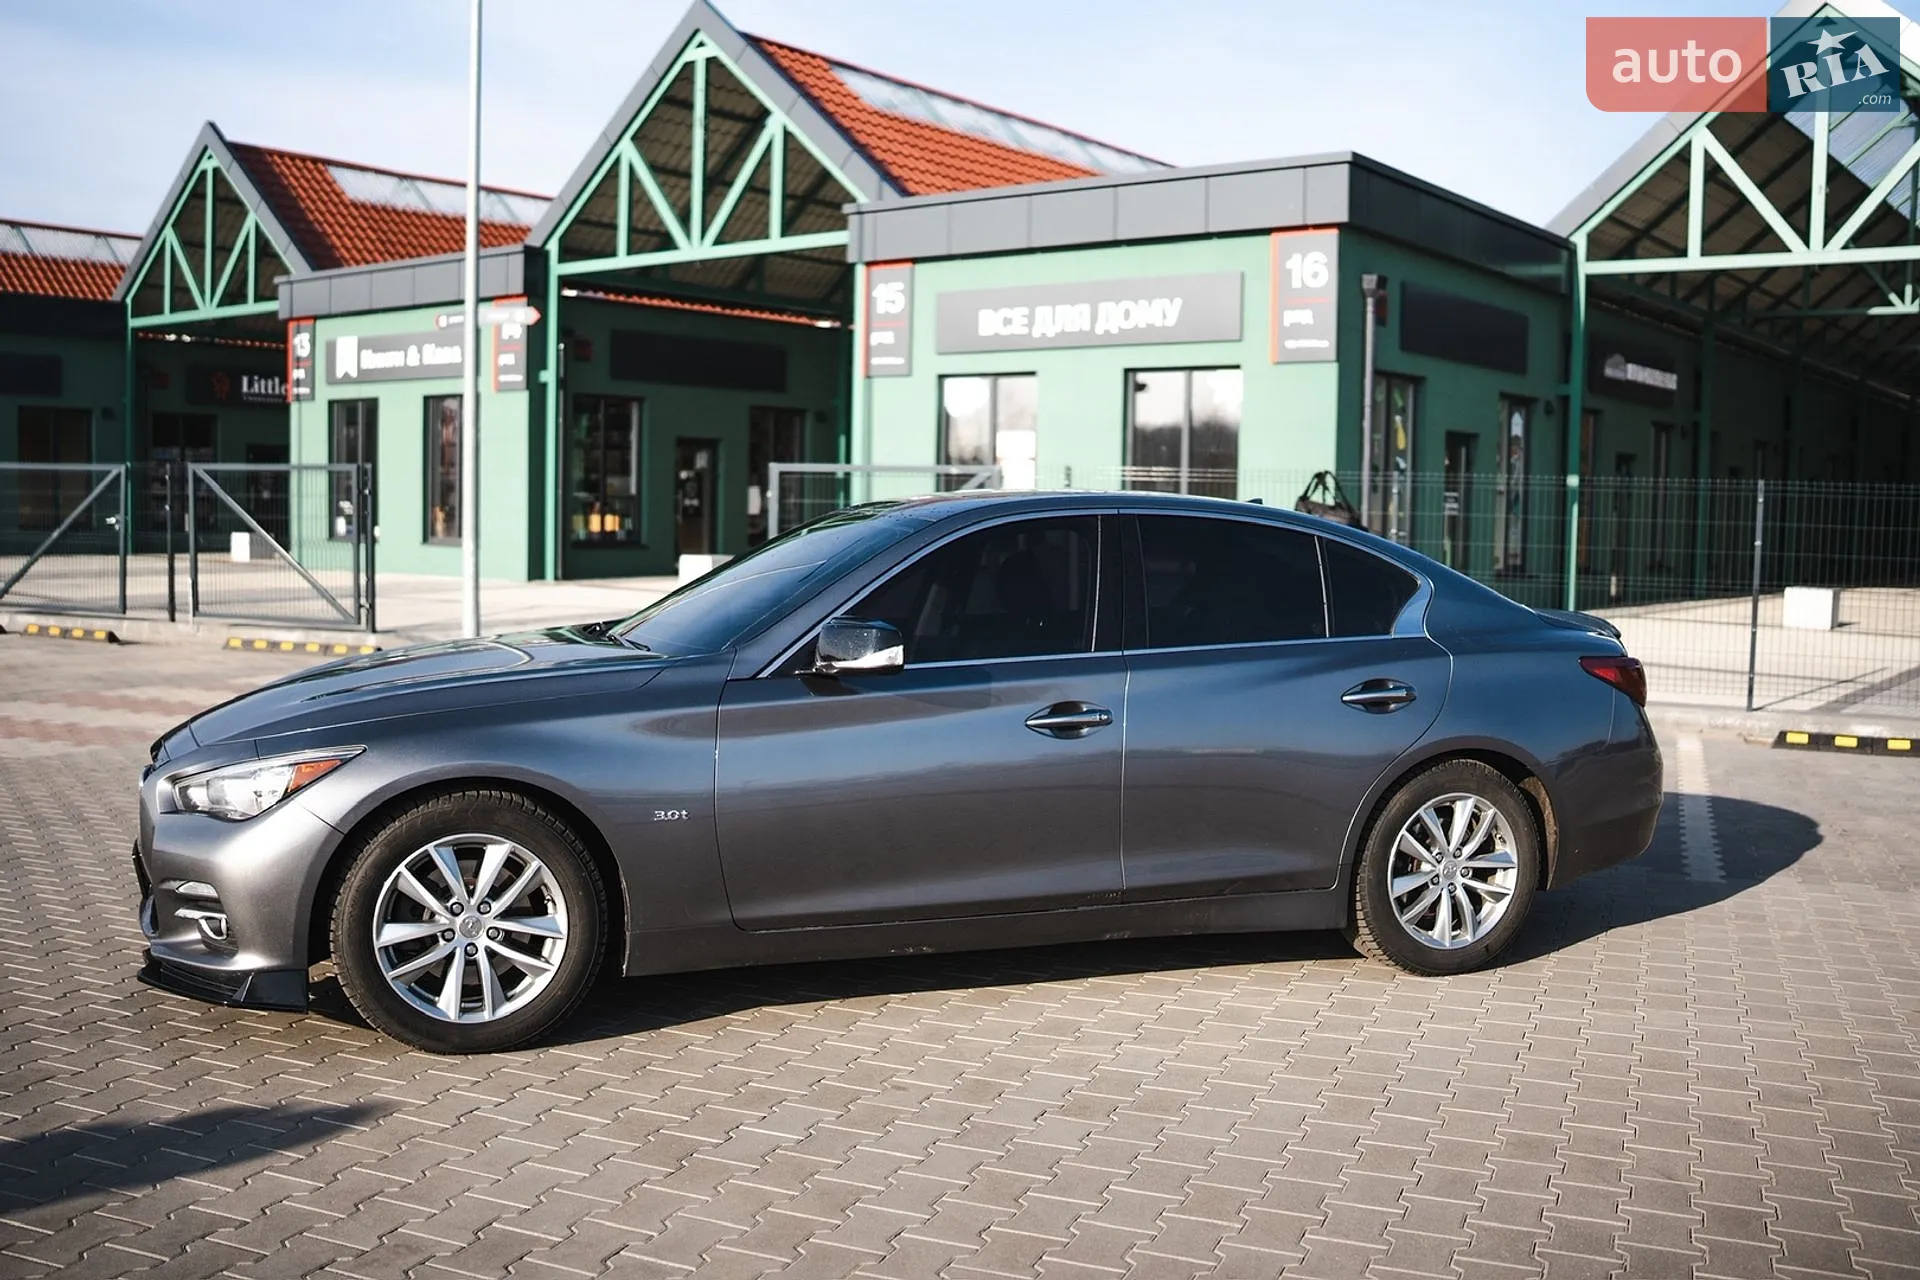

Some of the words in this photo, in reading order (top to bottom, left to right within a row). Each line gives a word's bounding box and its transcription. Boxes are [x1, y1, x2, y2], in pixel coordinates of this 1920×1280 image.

[1285, 251, 1329, 289] 16
[871, 281, 906, 315] 15
[978, 306, 1029, 336] ВСЕ
[1032, 303, 1091, 338] ДЛЯ
[1095, 297, 1183, 335] ДОМУ
